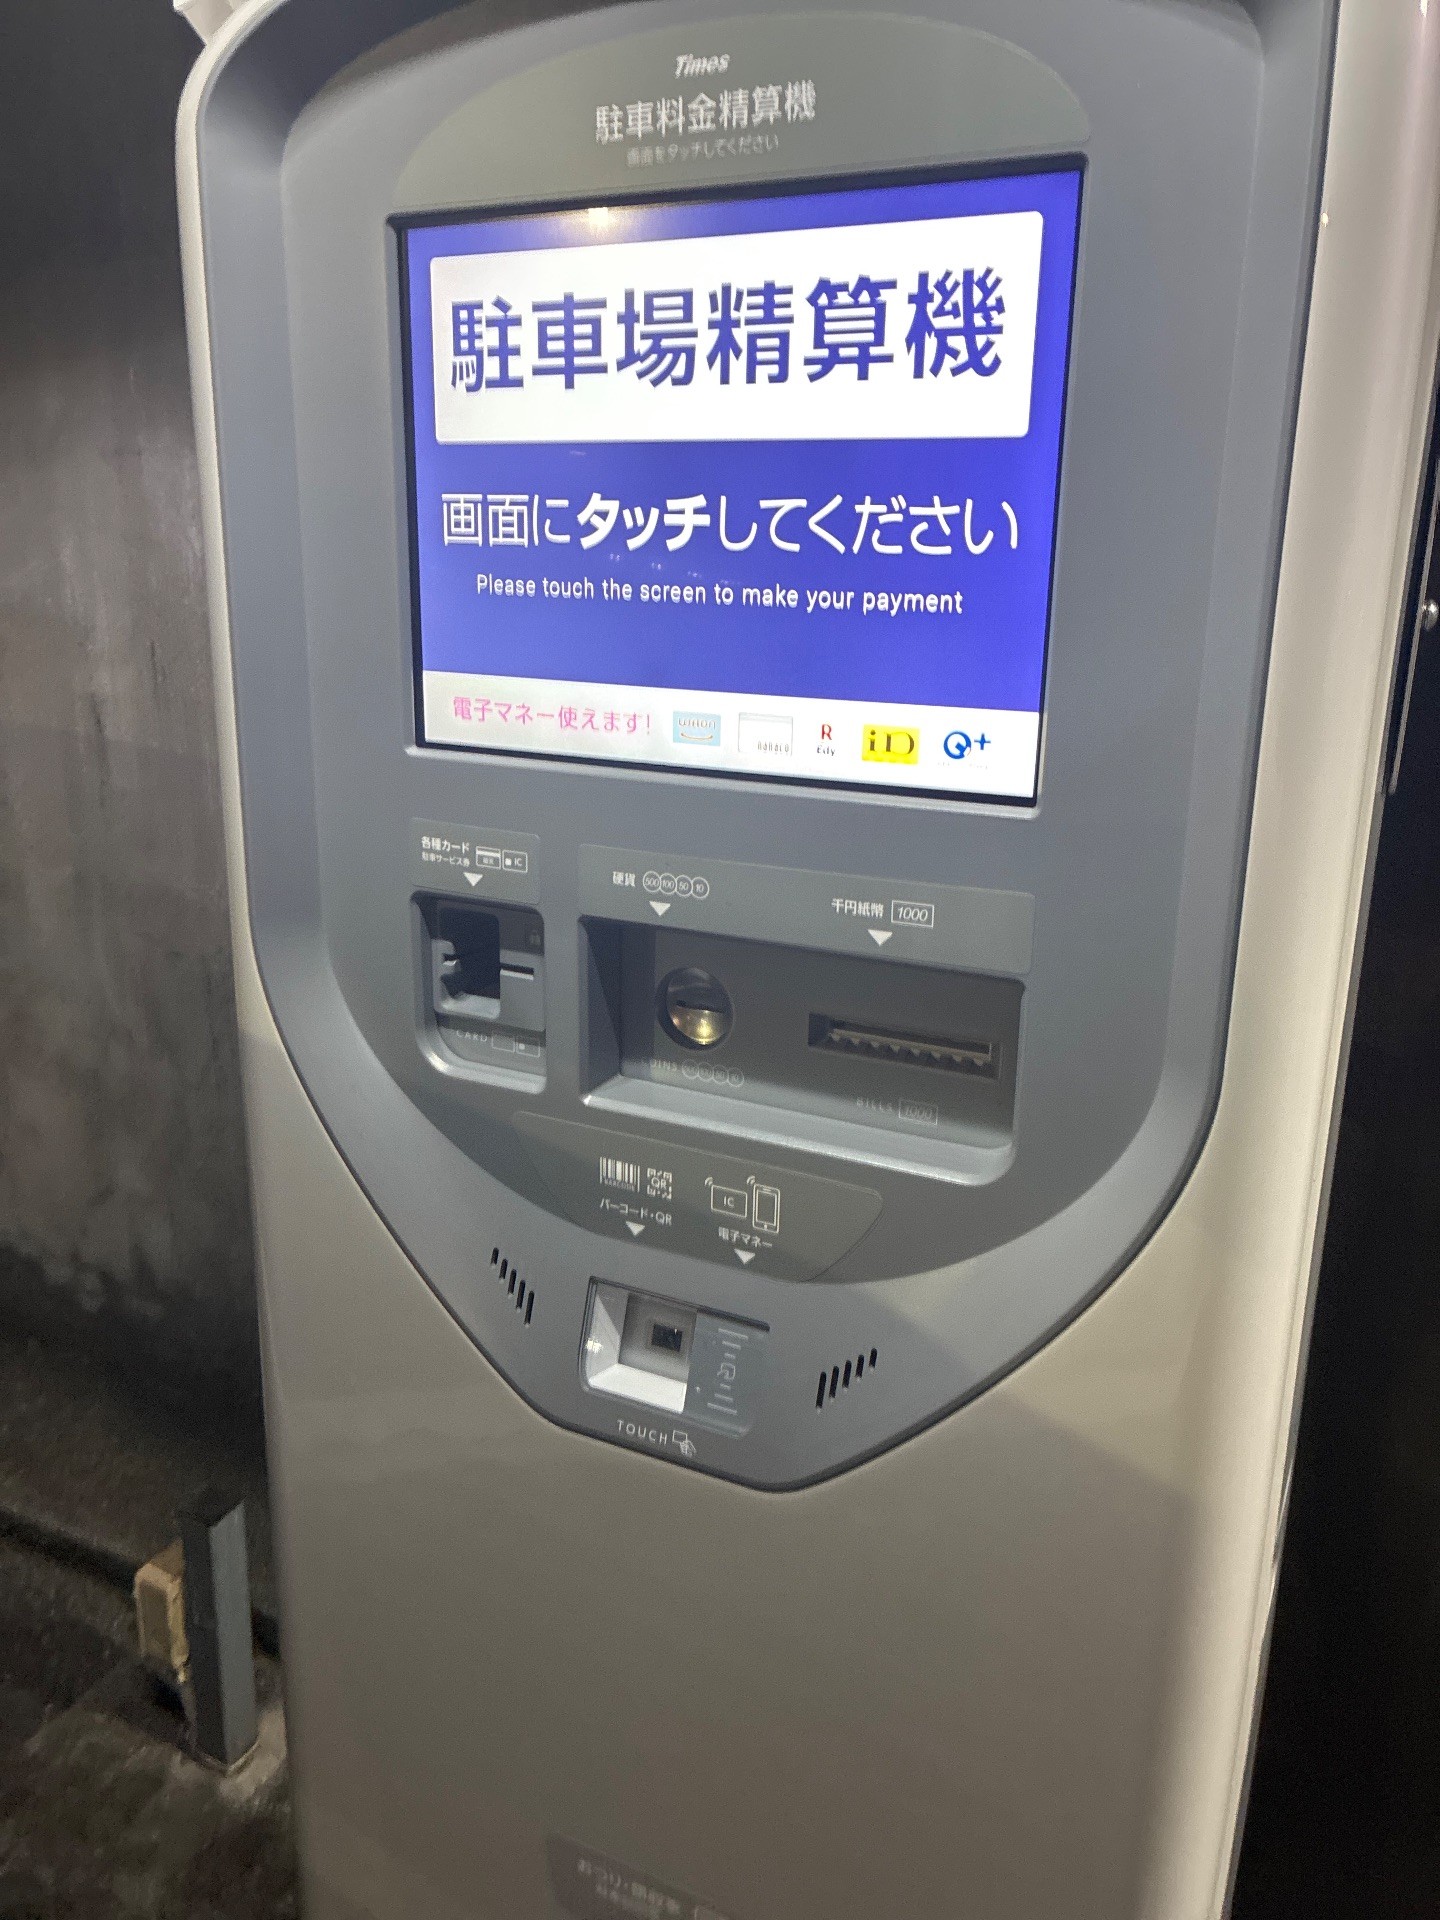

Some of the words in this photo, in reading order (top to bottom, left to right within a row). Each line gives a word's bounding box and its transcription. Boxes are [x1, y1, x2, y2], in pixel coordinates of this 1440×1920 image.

[674, 53, 730, 79] Times
[595, 79, 816, 145] 駐車料金精算機
[451, 266, 1006, 394] 駐車場精算機
[441, 492, 1019, 556] 画面にタッチしてください
[476, 573, 536, 598] Please
[542, 577, 595, 601] touch
[602, 578, 633, 602] the
[640, 584, 706, 606] screen
[714, 583, 733, 606] to
[741, 584, 799, 610] make
[805, 590, 855, 615] your
[862, 588, 963, 616] payment
[452, 696, 651, 735] 電子マネー使えます!
[421, 835, 470, 854] 各種カード
[513, 857, 523, 867] IC
[612, 871, 636, 888] 硬貨
[644, 876, 659, 888] 500
[661, 878, 675, 890] 100
[678, 881, 690, 892] 50
[694, 883, 705, 894] 10
[831, 898, 884, 919] 千円紙幣
[897, 906, 929, 922] 1000
[650, 1176, 667, 1190] QR
[723, 1195, 735, 1208] IC
[718, 1226, 773, 1248] 電子マネー
[616, 1419, 668, 1446] TOUCH
